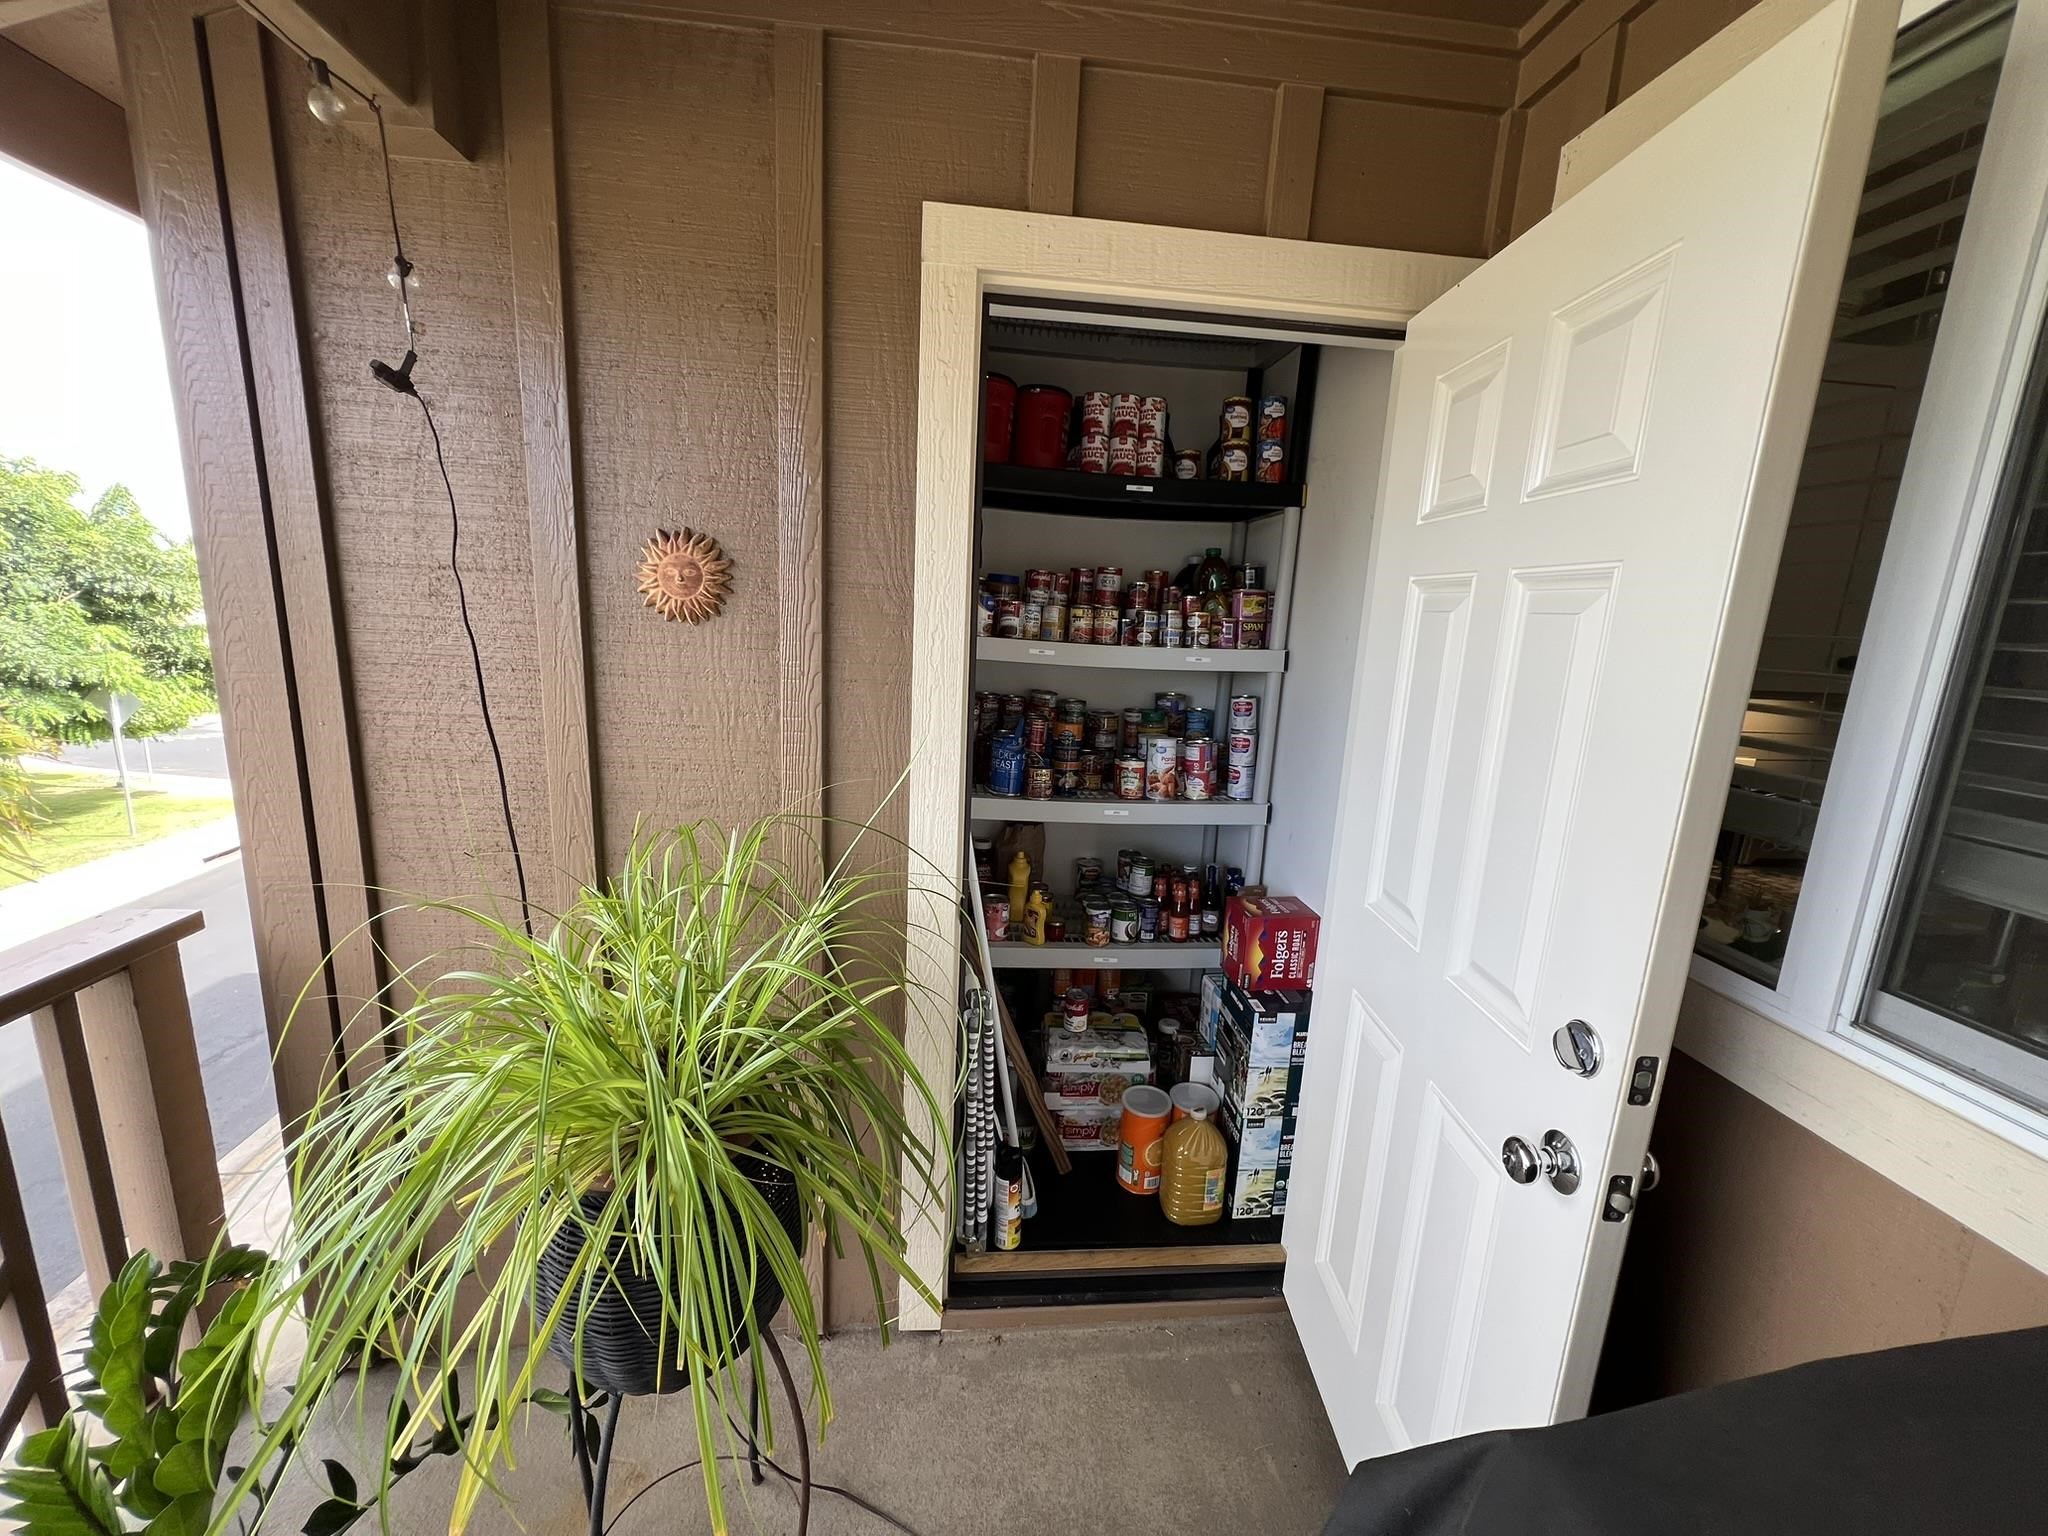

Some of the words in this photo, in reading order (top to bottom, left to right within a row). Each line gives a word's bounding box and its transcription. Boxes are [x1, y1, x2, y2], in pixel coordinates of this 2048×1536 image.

[1242, 622, 1264, 632] SPAM
[1291, 930, 1302, 951] ROAST
[1270, 930, 1290, 979] Folgers
[1288, 952, 1299, 979] CLASSIC
[1246, 1107, 1262, 1116] 120
[1064, 1124, 1098, 1137] simply
[1236, 1207, 1252, 1216] 120
